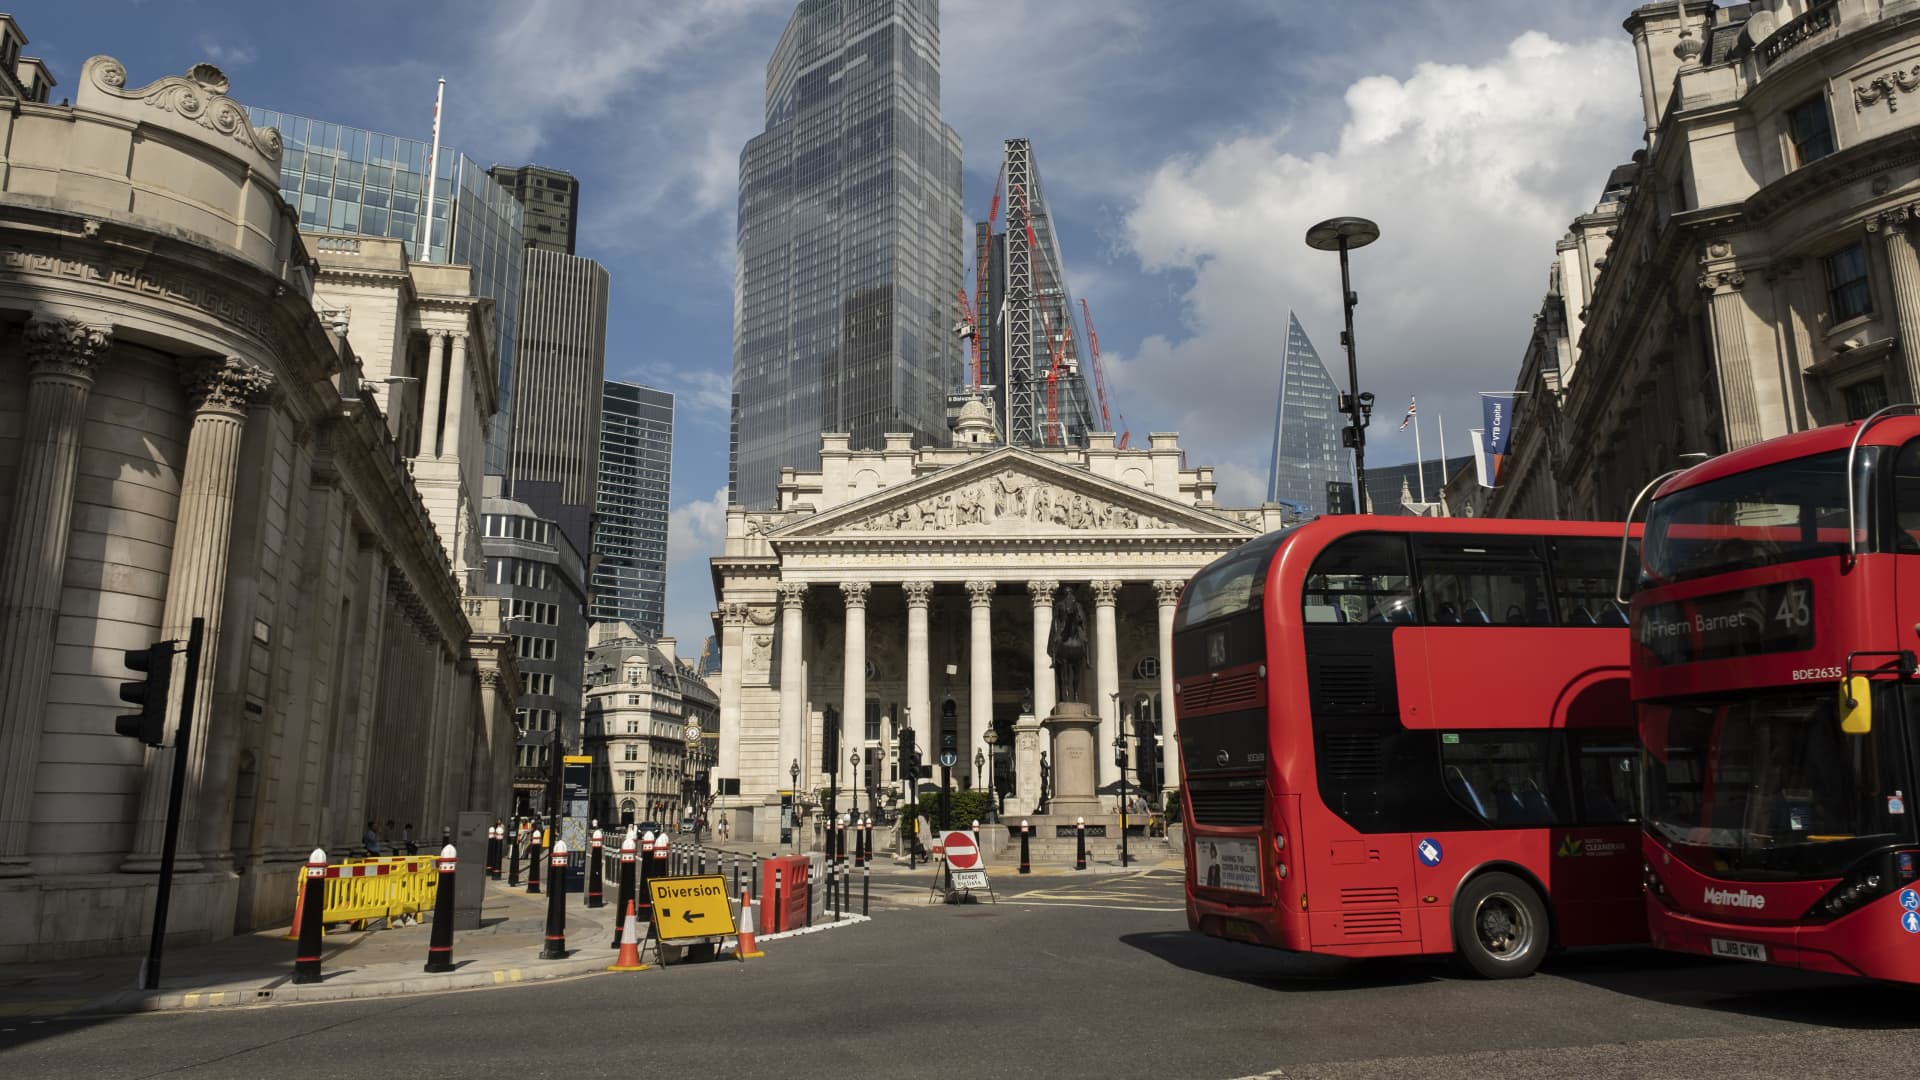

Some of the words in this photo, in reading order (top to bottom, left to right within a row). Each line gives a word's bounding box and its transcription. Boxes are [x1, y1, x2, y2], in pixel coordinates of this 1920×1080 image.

[1493, 403, 1502, 425] Capital
[1493, 425, 1501, 441] VTB
[1651, 619, 1691, 639] Friern
[1696, 612, 1746, 632] Barnet
[1775, 590, 1810, 629] 43
[1792, 667, 1843, 681] BDE2635
[657, 885, 721, 899] Diversion
[1704, 887, 1766, 909] Metroline
